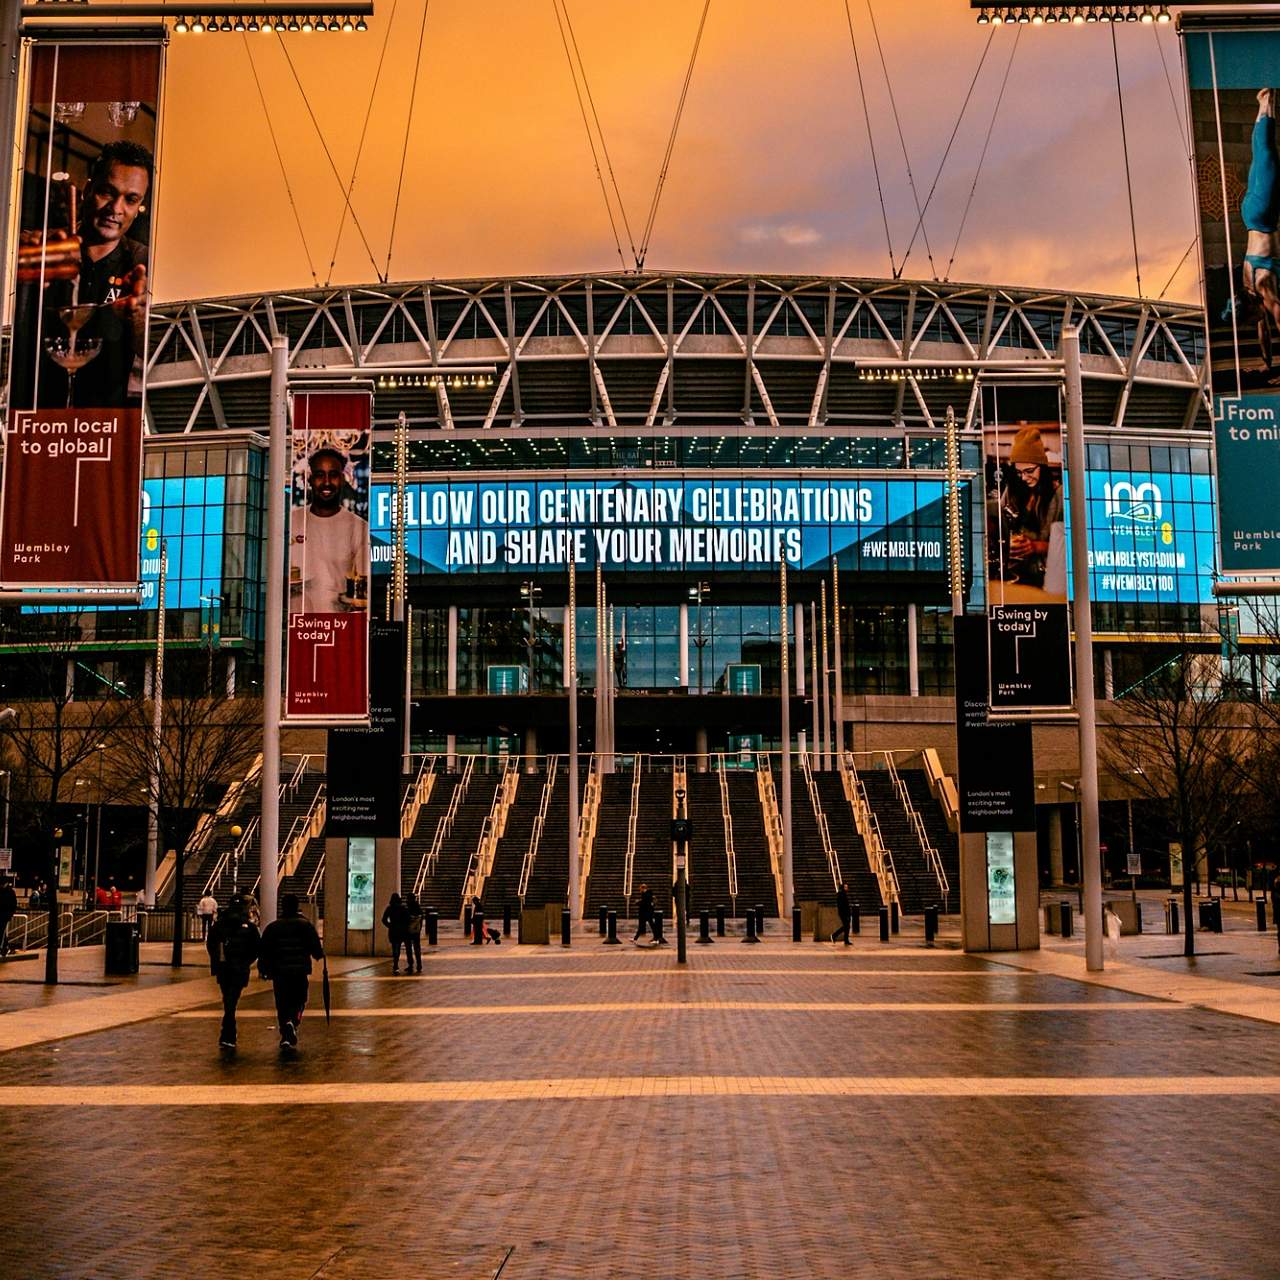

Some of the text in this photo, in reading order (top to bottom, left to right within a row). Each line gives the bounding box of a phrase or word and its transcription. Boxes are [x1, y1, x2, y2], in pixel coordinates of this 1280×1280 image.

[1227, 404, 1274, 421] From
[22, 417, 118, 434] From local
[1228, 425, 1251, 441] to
[20, 437, 104, 458] to global
[481, 489, 531, 524] OUR
[539, 488, 684, 524] CENTENARY
[692, 487, 873, 523] CELEBRATIONS
[1103, 481, 1162, 521] 100
[14, 543, 70, 554] Wembley
[445, 528, 802, 565] AND SHARE YOUR MEMORIES
[1234, 541, 1263, 551] Park
[13, 554, 41, 563] Park
[1102, 574, 1174, 592] #WEMBLEY100
[997, 609, 1049, 621] Swing by
[297, 617, 348, 630] Swing by
[997, 621, 1032, 633] today
[296, 630, 330, 642] today
[998, 683, 1032, 691] Wembley
